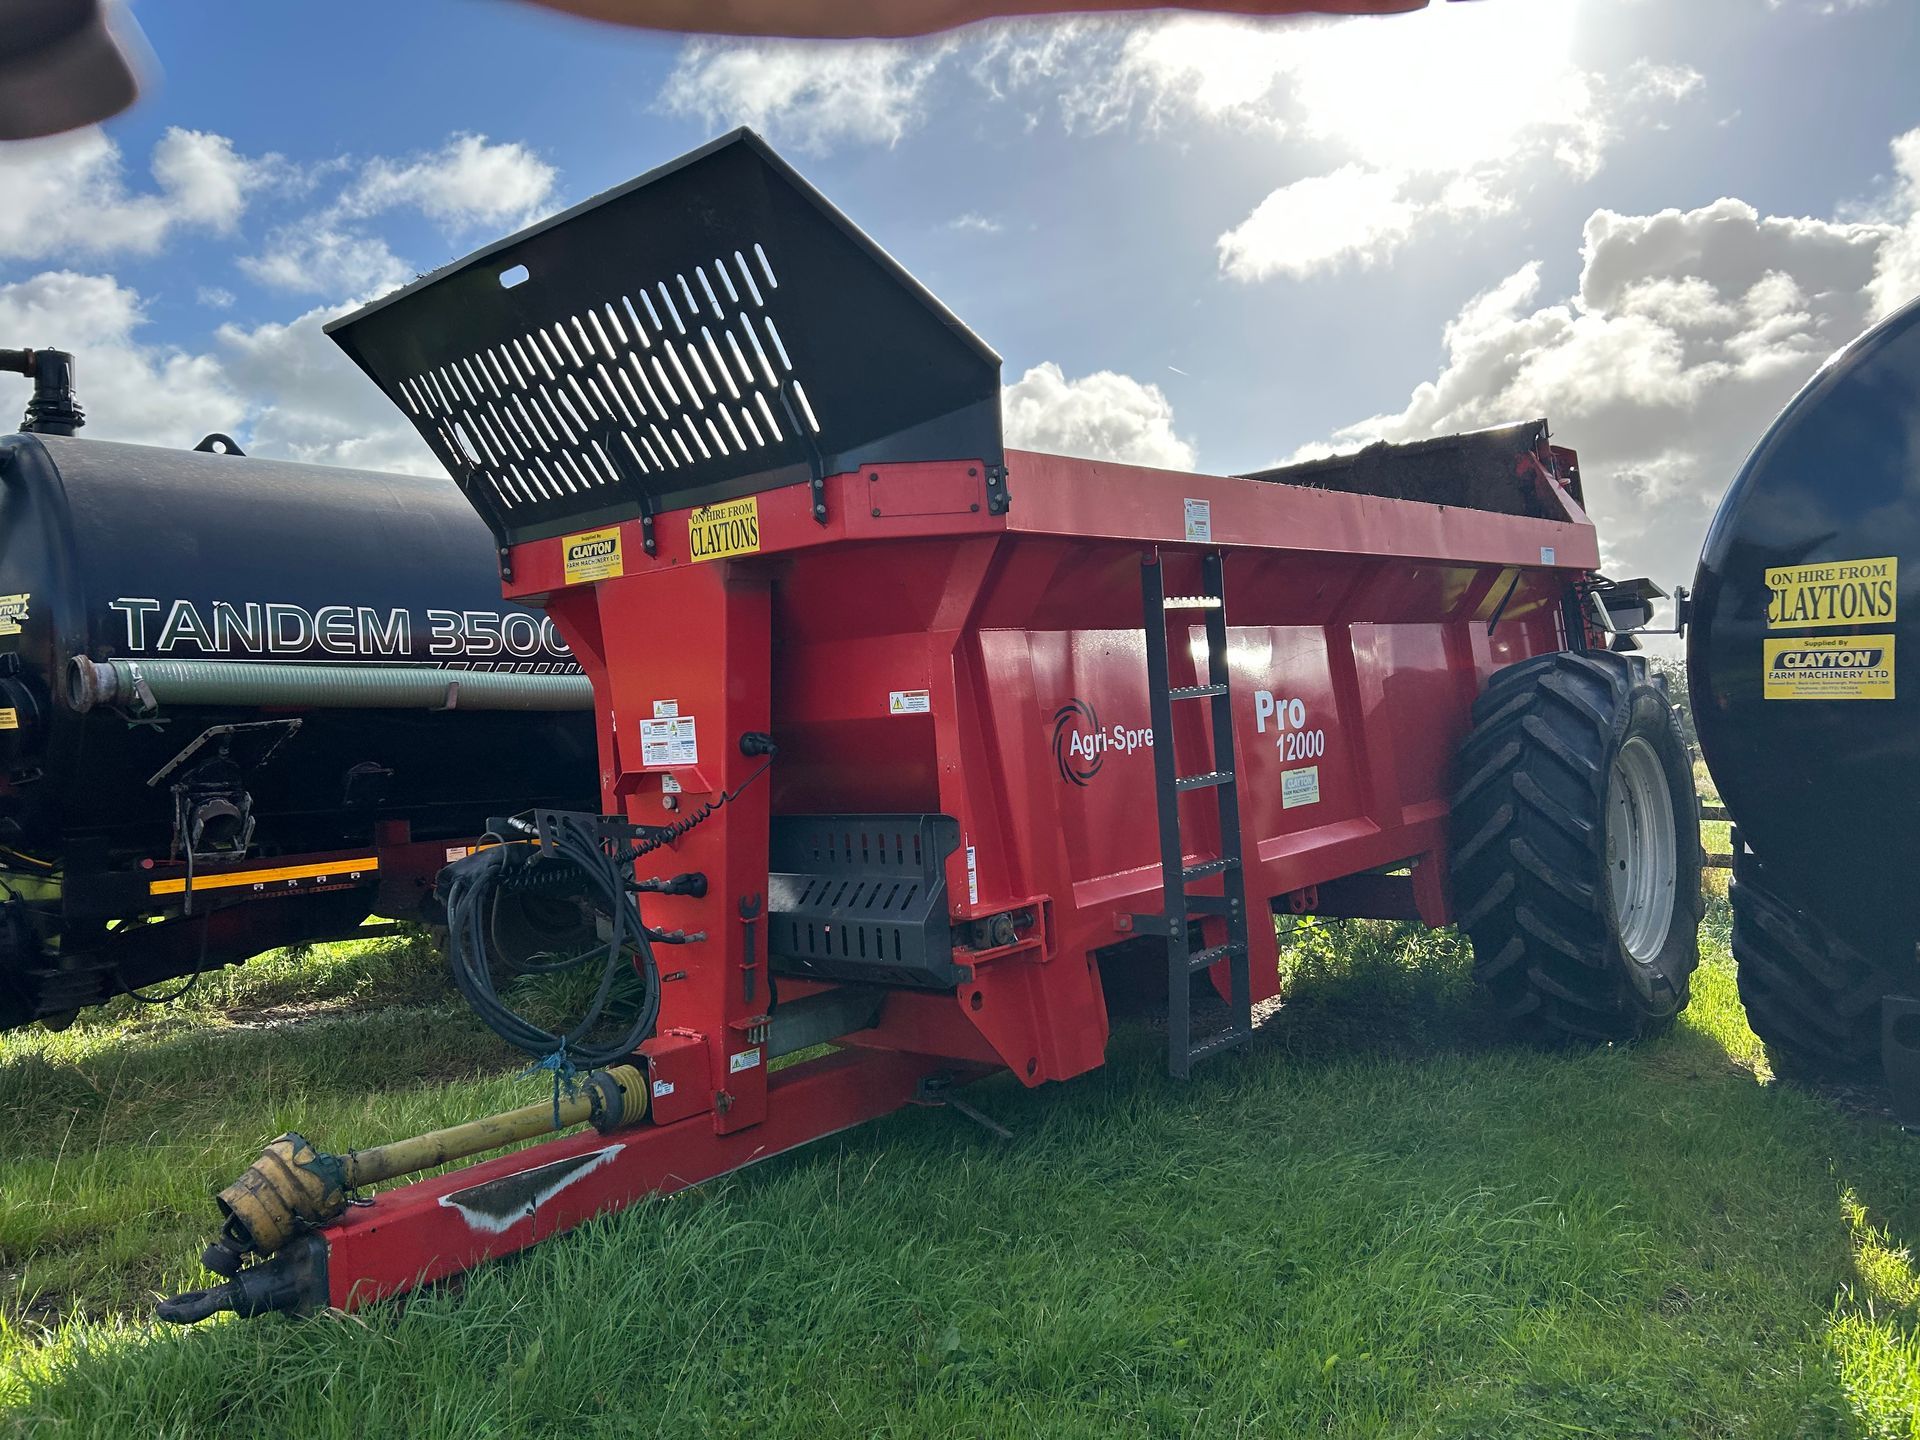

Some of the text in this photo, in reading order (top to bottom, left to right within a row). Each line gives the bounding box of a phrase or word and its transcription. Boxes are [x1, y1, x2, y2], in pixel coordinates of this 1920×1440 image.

[692, 503, 753, 524] ON HIRE FROM
[572, 540, 611, 559] CLAYTON
[691, 516, 758, 557] CLAYTONS
[1771, 564, 1887, 586] ON HIRE FROM
[1768, 580, 1892, 623] CLAYTONS
[109, 597, 412, 656] TANDEM
[1783, 651, 1871, 668] CLAYTON
[1800, 670, 1864, 679] MACHINERY
[1867, 670, 1889, 678] LTD
[1255, 690, 1306, 733] Pro
[1069, 725, 1154, 761] Agri-Spre
[1276, 729, 1325, 762] 12000
